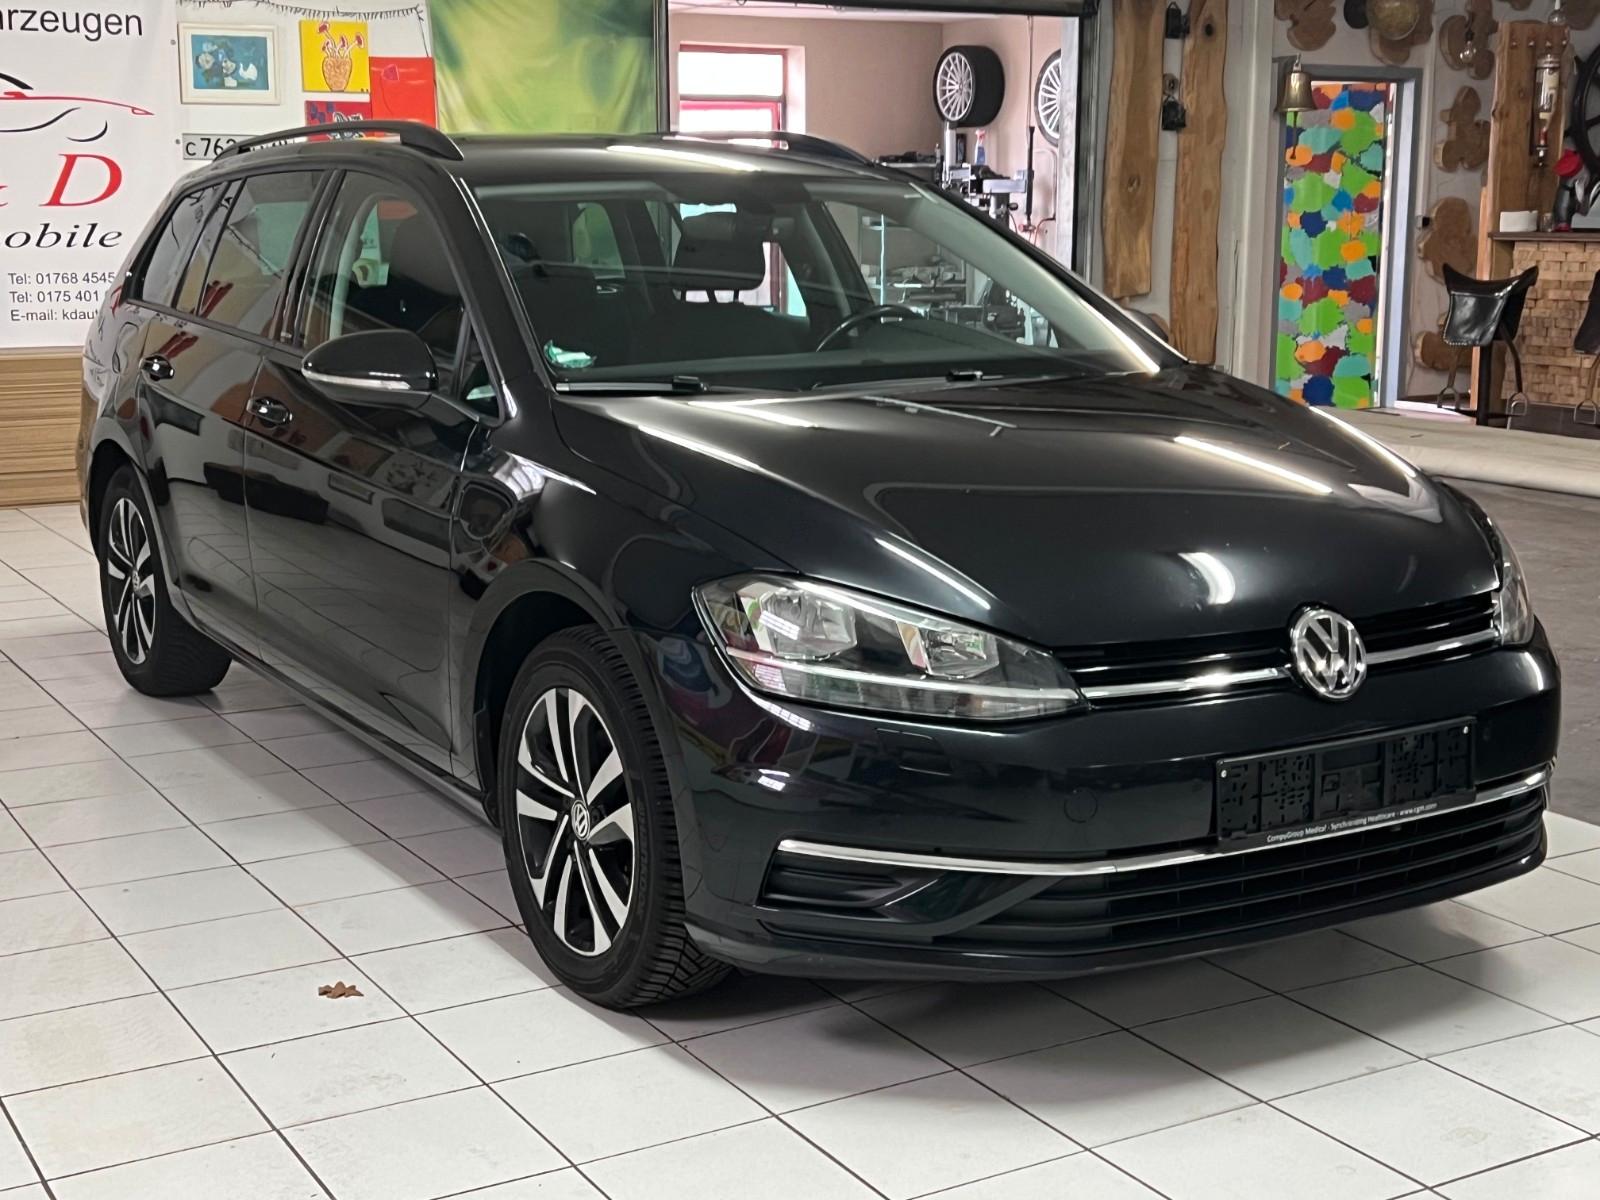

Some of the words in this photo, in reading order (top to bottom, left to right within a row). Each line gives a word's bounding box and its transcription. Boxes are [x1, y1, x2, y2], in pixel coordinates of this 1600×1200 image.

[38, 154, 122, 206] D
[8, 272, 31, 285] Tel:
[35, 272, 79, 284] 01768
[9, 291, 32, 303] Tel:
[37, 290, 71, 302] 0175
[75, 289, 99, 301] 401
[10, 308, 58, 321] E-mail:
